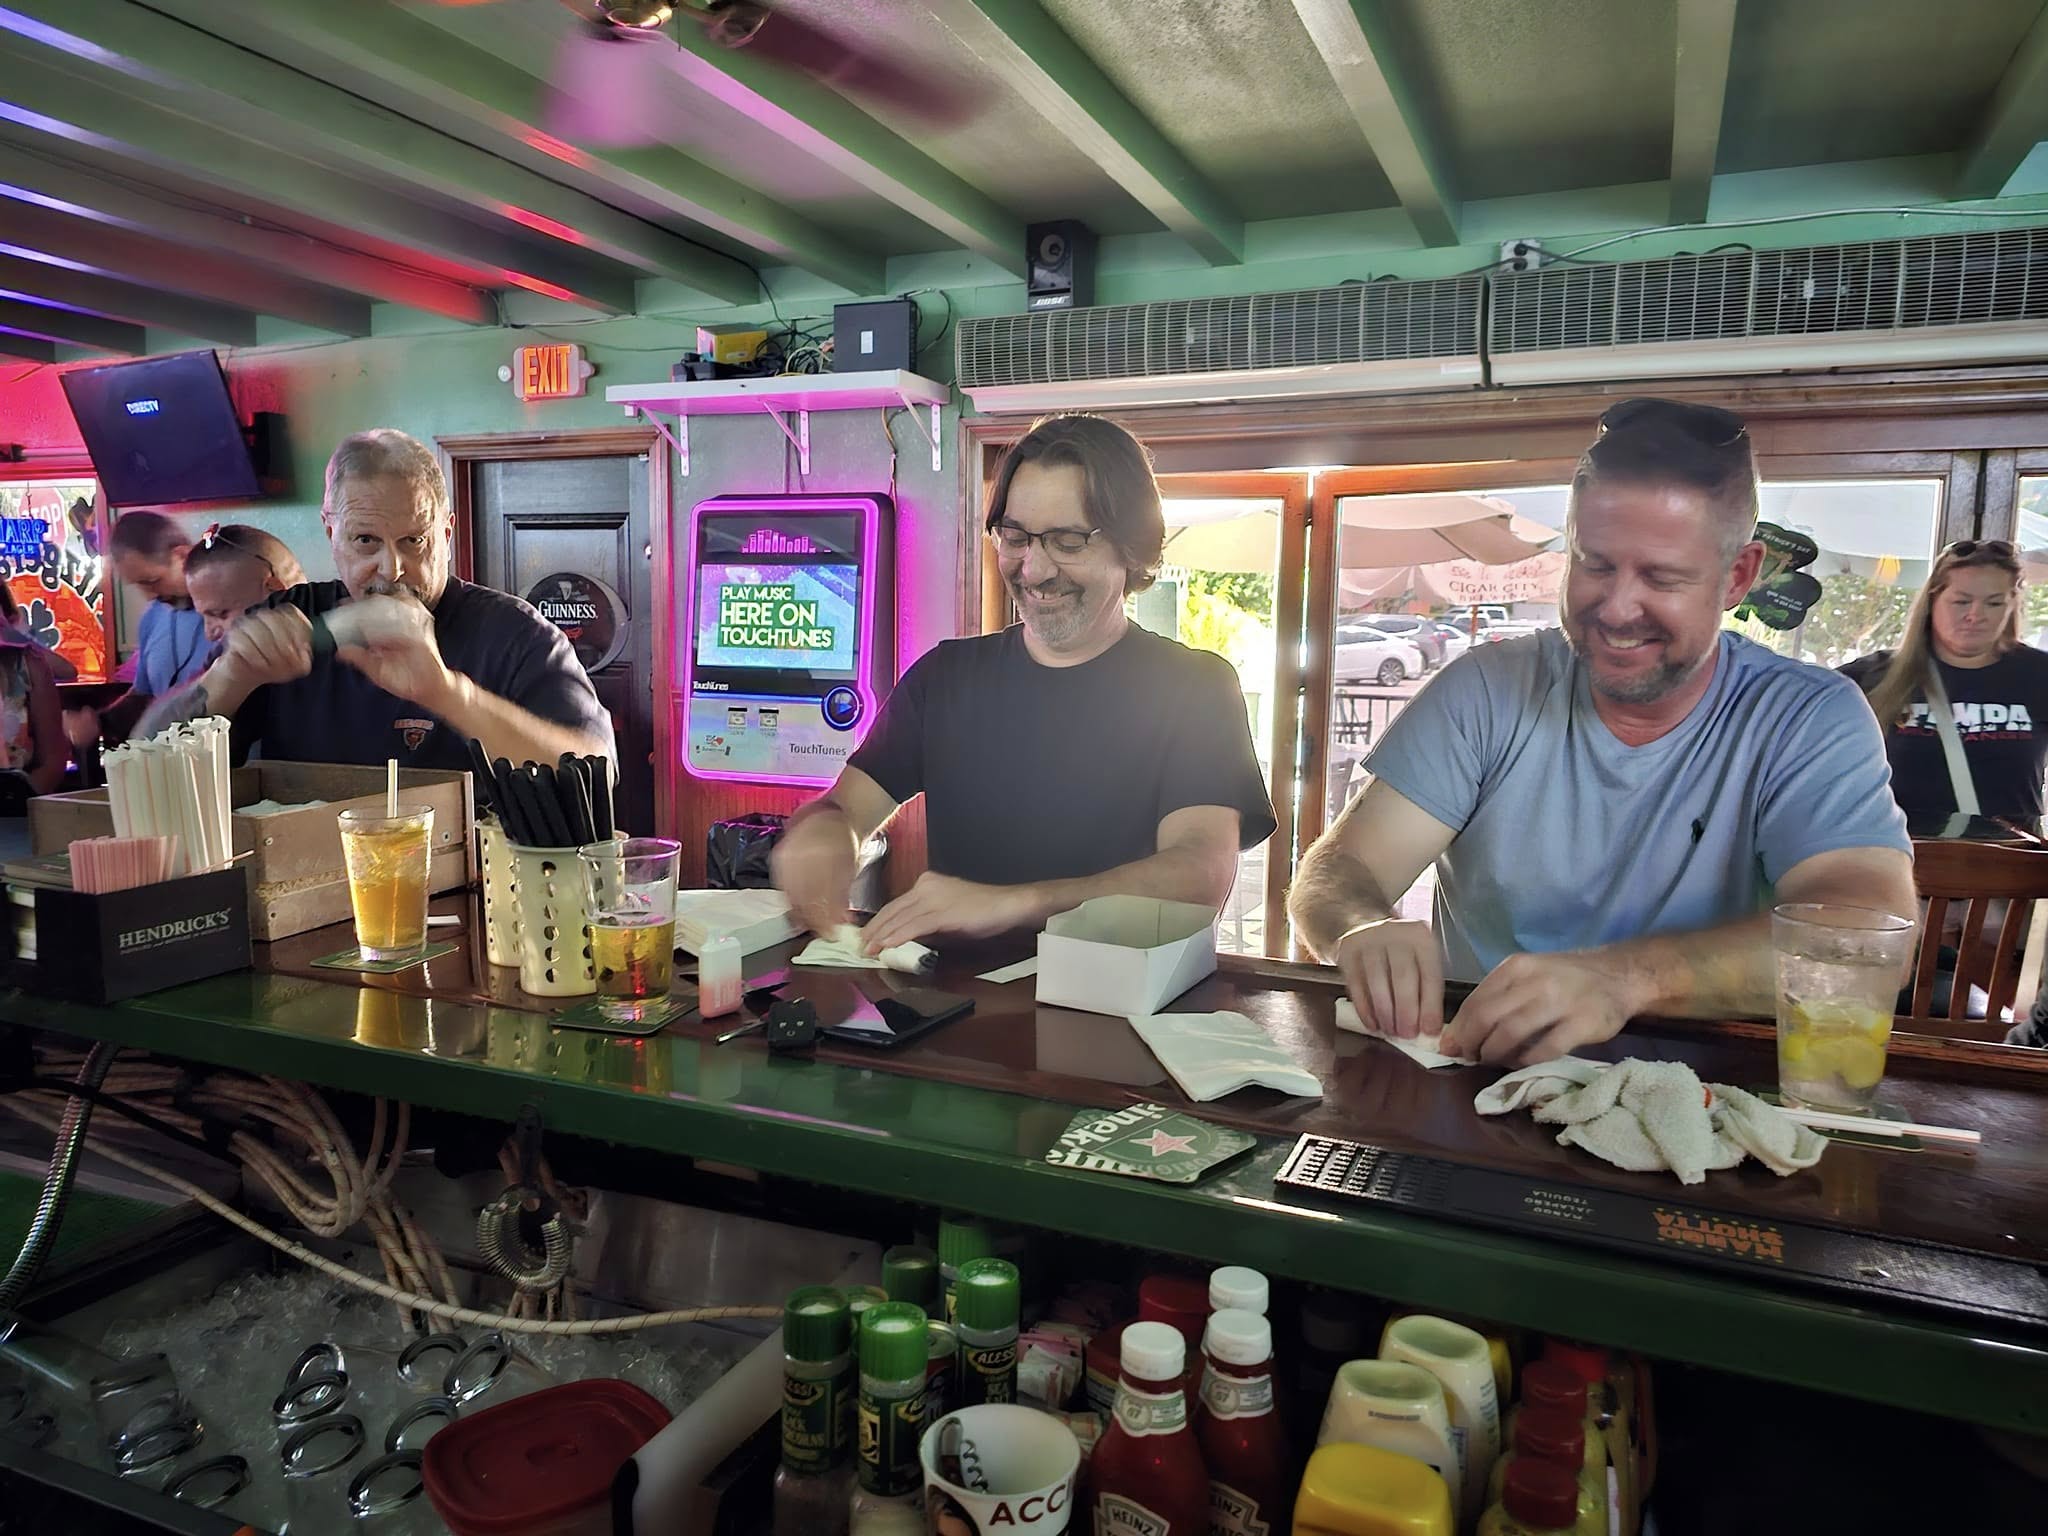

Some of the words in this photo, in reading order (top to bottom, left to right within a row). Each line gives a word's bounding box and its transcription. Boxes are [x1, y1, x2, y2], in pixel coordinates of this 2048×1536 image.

[523, 345, 571, 396] EXIT
[0, 519, 44, 544] ARP
[721, 586, 752, 600] PLAY
[753, 587, 792, 601] MUSIC
[1448, 580, 1498, 594] CIGAR
[538, 600, 597, 619] GUINNESS
[720, 601, 775, 626] HERE
[778, 602, 817, 627] ON
[720, 626, 832, 648] TOUCHTUNES
[1901, 702, 2032, 732] TMPA
[789, 743, 847, 756] TouchTunes
[119, 908, 231, 949] HENDRICK'S
[1532, 1189, 1588, 1206] TEQUILA
[1653, 1211, 1785, 1247] SHOTTA
[1656, 1225, 1783, 1258] MANGO
[1112, 1507, 1154, 1535] HEINZ
